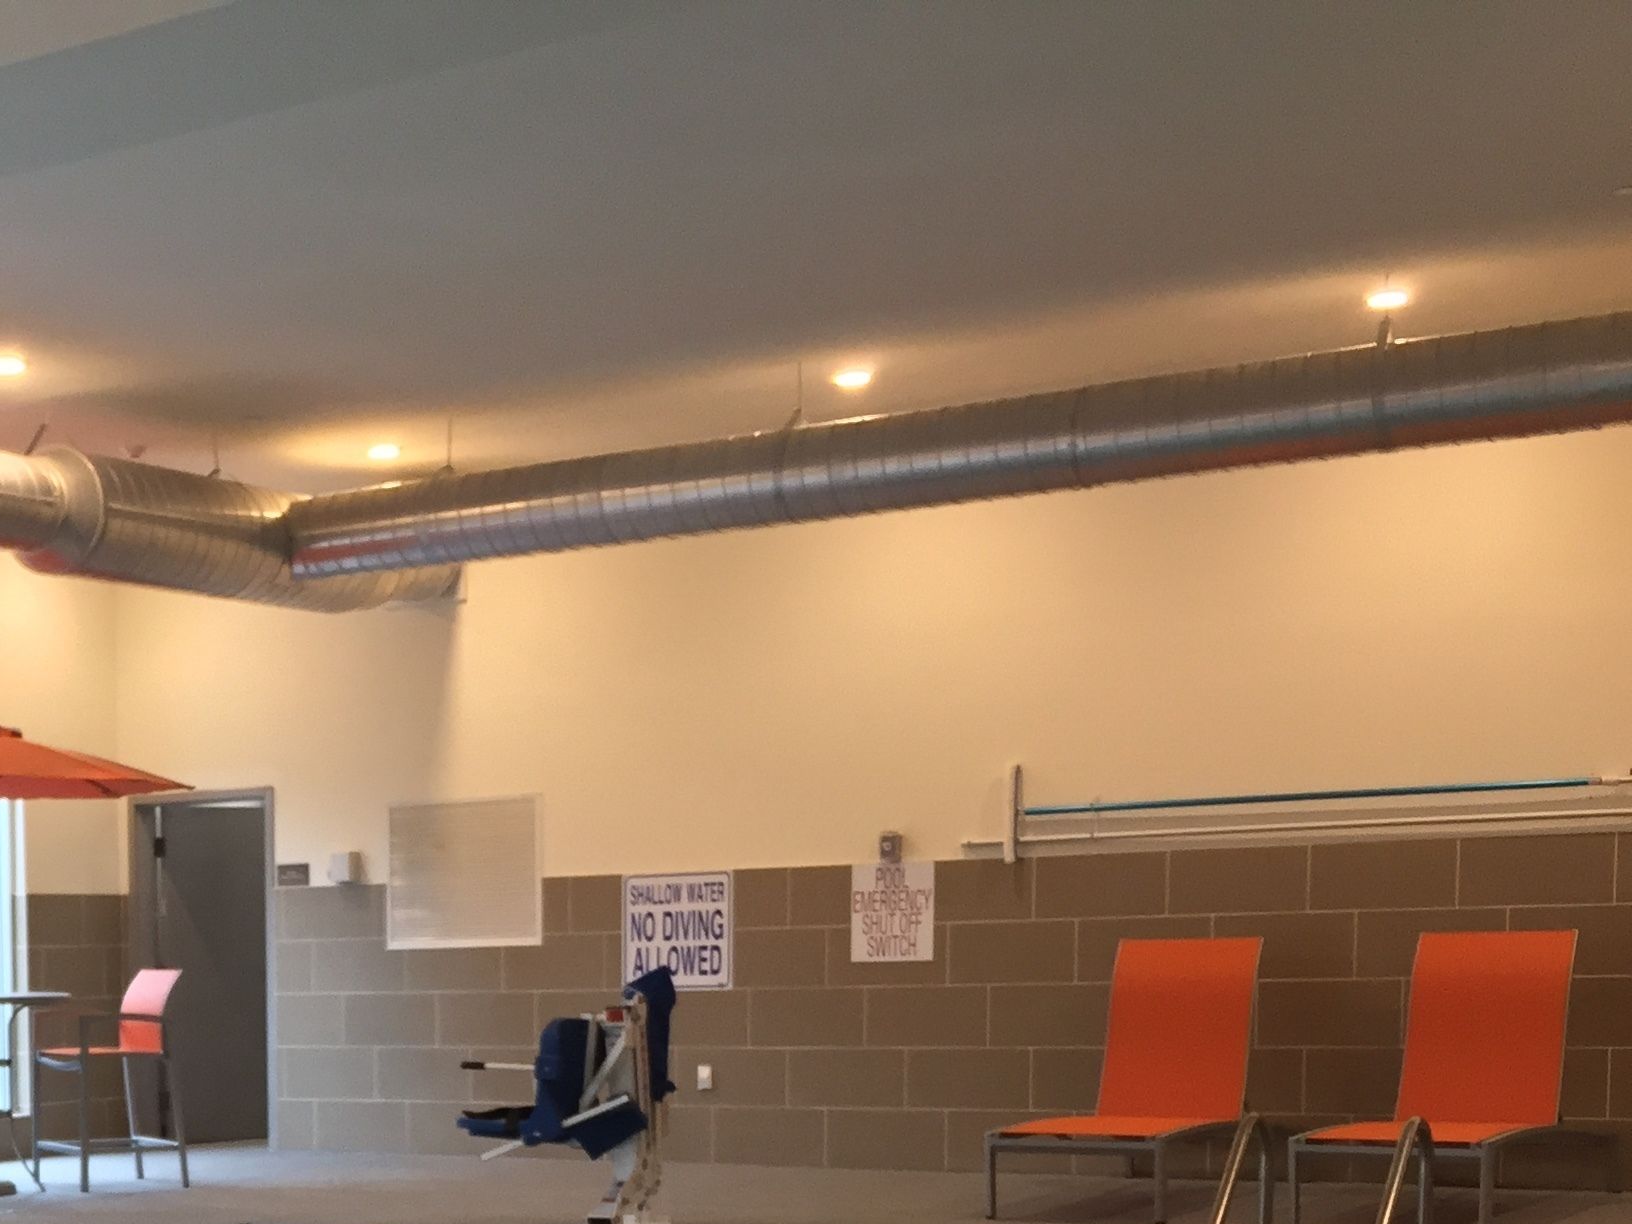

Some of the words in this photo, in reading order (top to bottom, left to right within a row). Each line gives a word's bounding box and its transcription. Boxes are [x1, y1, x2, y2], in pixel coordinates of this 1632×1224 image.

[875, 867, 910, 890] POOL
[630, 884, 682, 906] SHALLOW
[687, 881, 724, 903] WATER
[853, 888, 932, 913] EMERGENCY
[630, 911, 655, 942] NO
[662, 908, 724, 941] DIVING
[862, 913, 896, 936] SHUT
[899, 911, 922, 934] OFF
[866, 935, 916, 957] SWITCH
